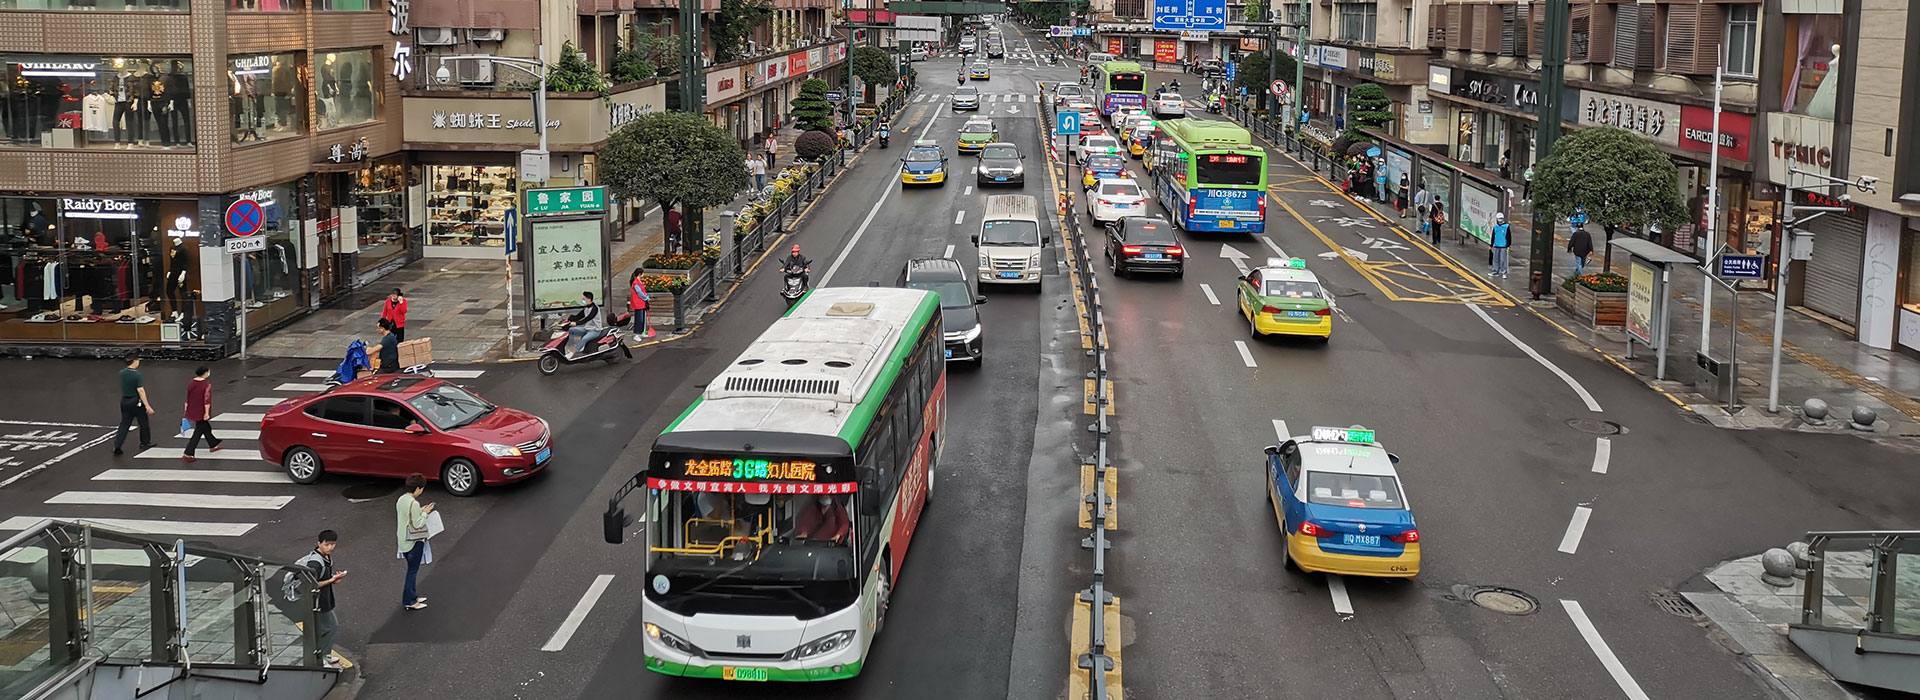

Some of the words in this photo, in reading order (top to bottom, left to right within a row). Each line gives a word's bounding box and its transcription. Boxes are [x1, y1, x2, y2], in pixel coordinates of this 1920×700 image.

[235, 56, 270, 68] GHILARO
[450, 113, 502, 129] 蜘蛛王
[505, 117, 534, 130] Spide
[1685, 128, 1713, 143] EARCO
[258, 189, 274, 199] Boer
[537, 190, 594, 205] 鲁家园
[1207, 189, 1247, 199] 川Q38673
[63, 198, 102, 212] Raidy
[104, 199, 136, 211] Boer
[230, 240, 254, 250] 200m
[538, 243, 582, 255] 宜人生态
[553, 258, 597, 270] 宾归自然
